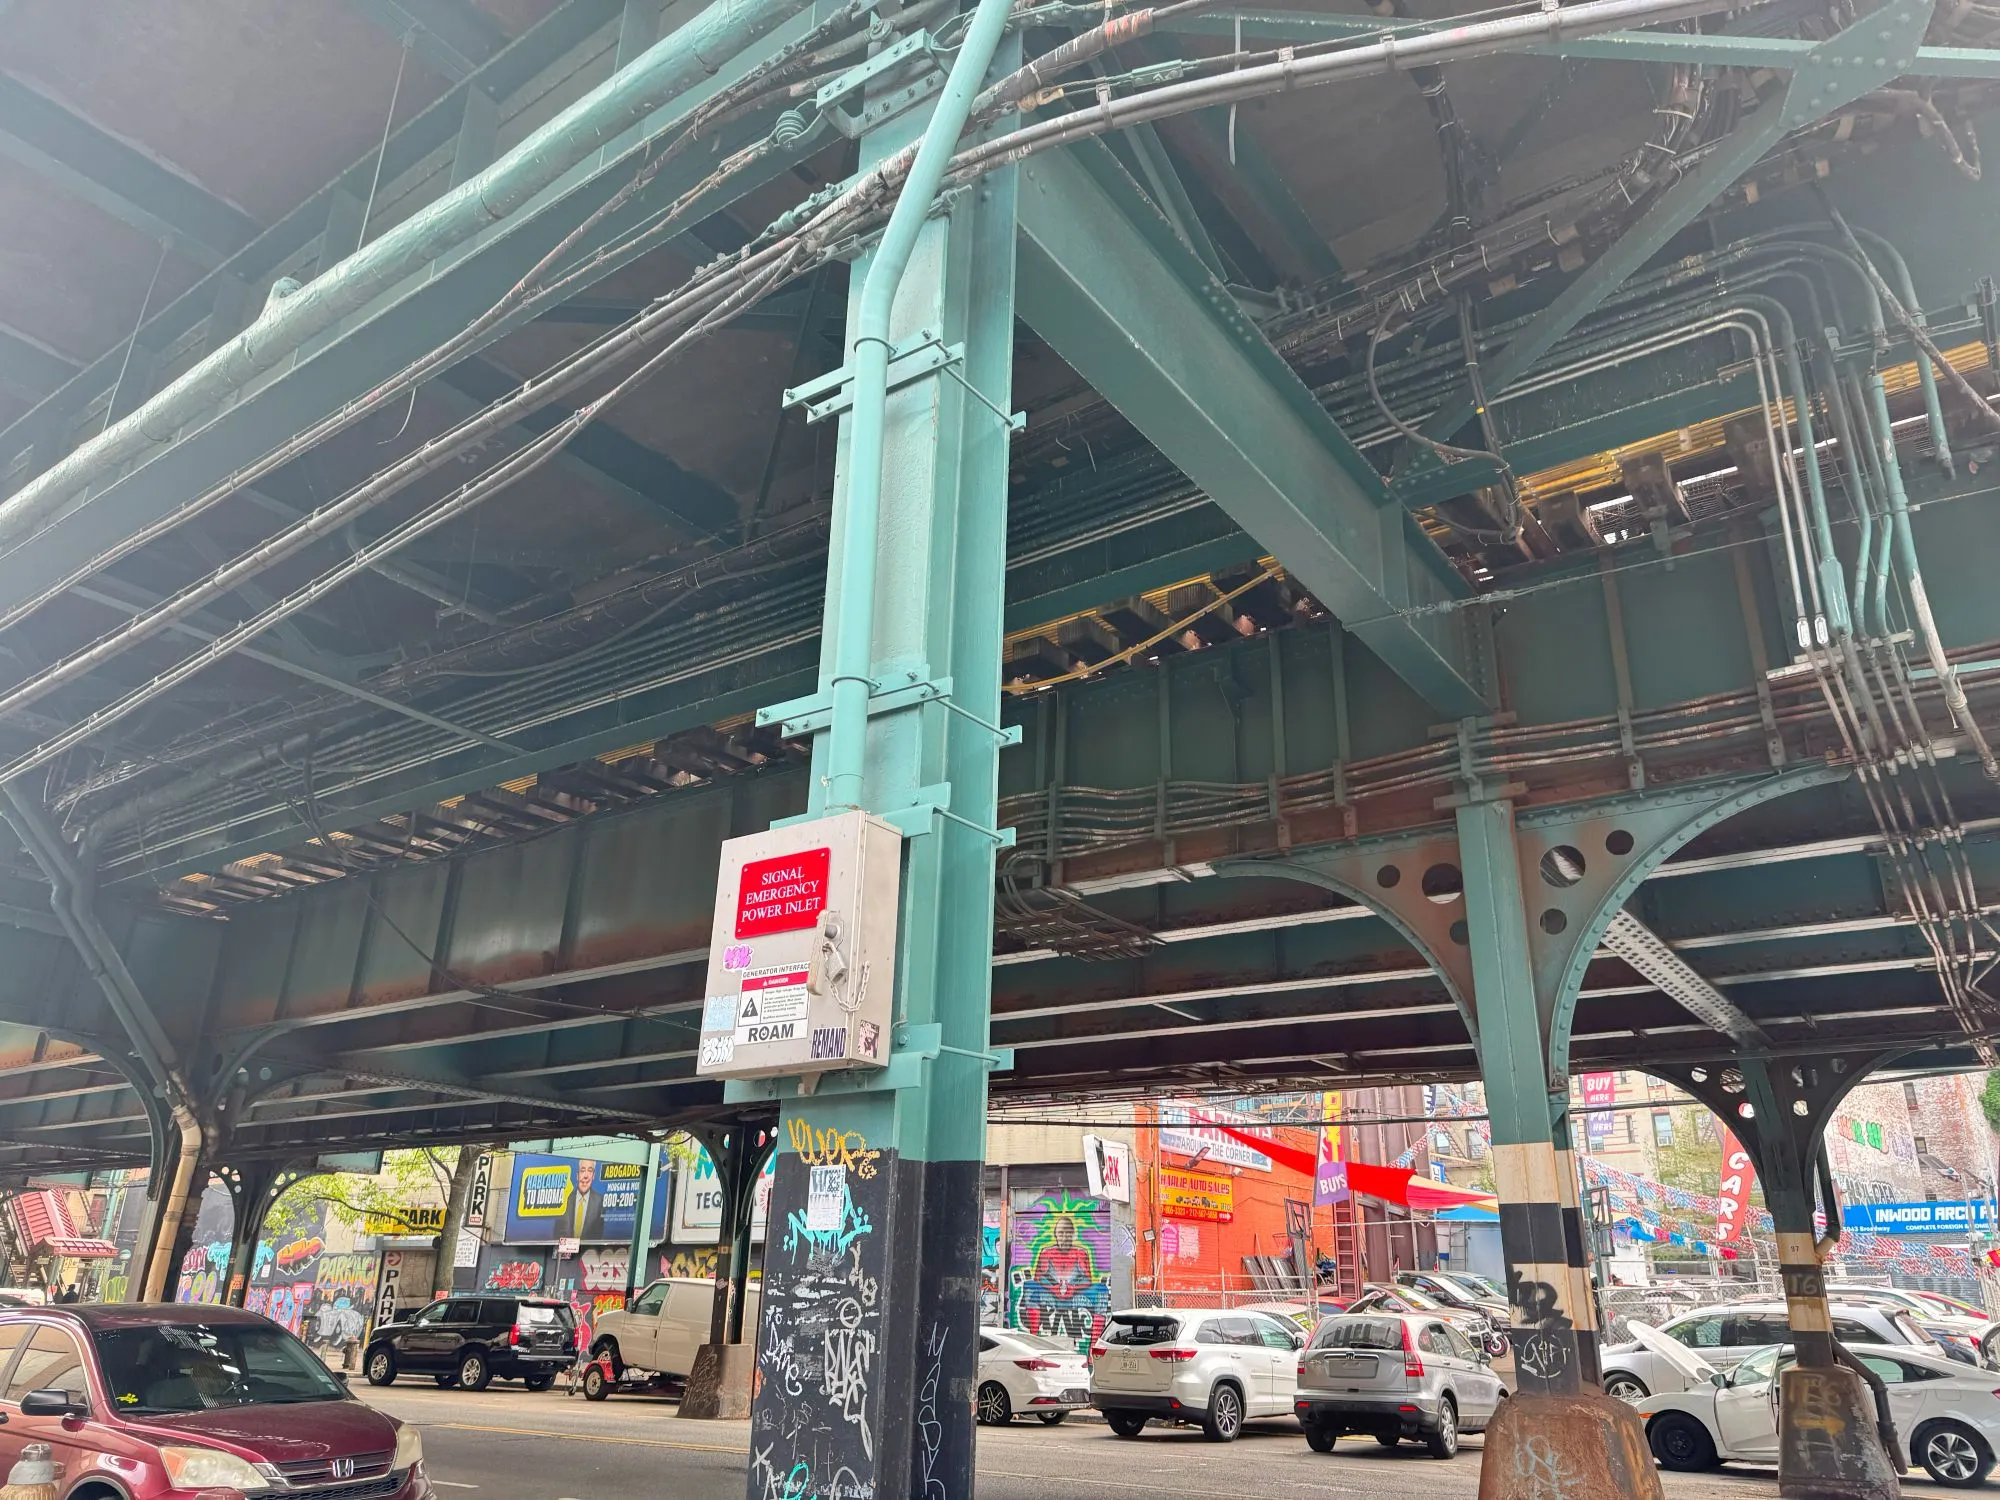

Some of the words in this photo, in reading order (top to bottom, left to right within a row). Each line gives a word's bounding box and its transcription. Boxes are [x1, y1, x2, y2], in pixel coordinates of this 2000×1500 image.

[761, 866, 805, 886] SIGNAL
[745, 880, 820, 905] EMERGENCY
[741, 904, 782, 923] POWER
[785, 897, 821, 915] INLET
[743, 967, 778, 978] GENERATOR
[779, 962, 809, 972] INTERFAC
[748, 1023, 795, 1043] ROAM
[811, 1027, 847, 1059] REMAND
[1586, 1076, 1611, 1092] BUY
[1590, 1093, 1610, 1102] HERE
[1211, 1142, 1224, 1158] THE
[1225, 1146, 1251, 1161] CORNER
[604, 1164, 641, 1178] ABOGADOS
[471, 1156, 490, 1216] PARK
[526, 1174, 568, 1189] HABLAMOS
[1320, 1174, 1347, 1194] BUYS
[537, 1188, 564, 1204] IDIOMA
[1717, 1152, 1750, 1240] CARS
[1876, 1207, 1931, 1223] INWOOD
[1860, 1225, 1891, 1233] Broadway
[1937, 1222, 1963, 1230] FOREIGN
